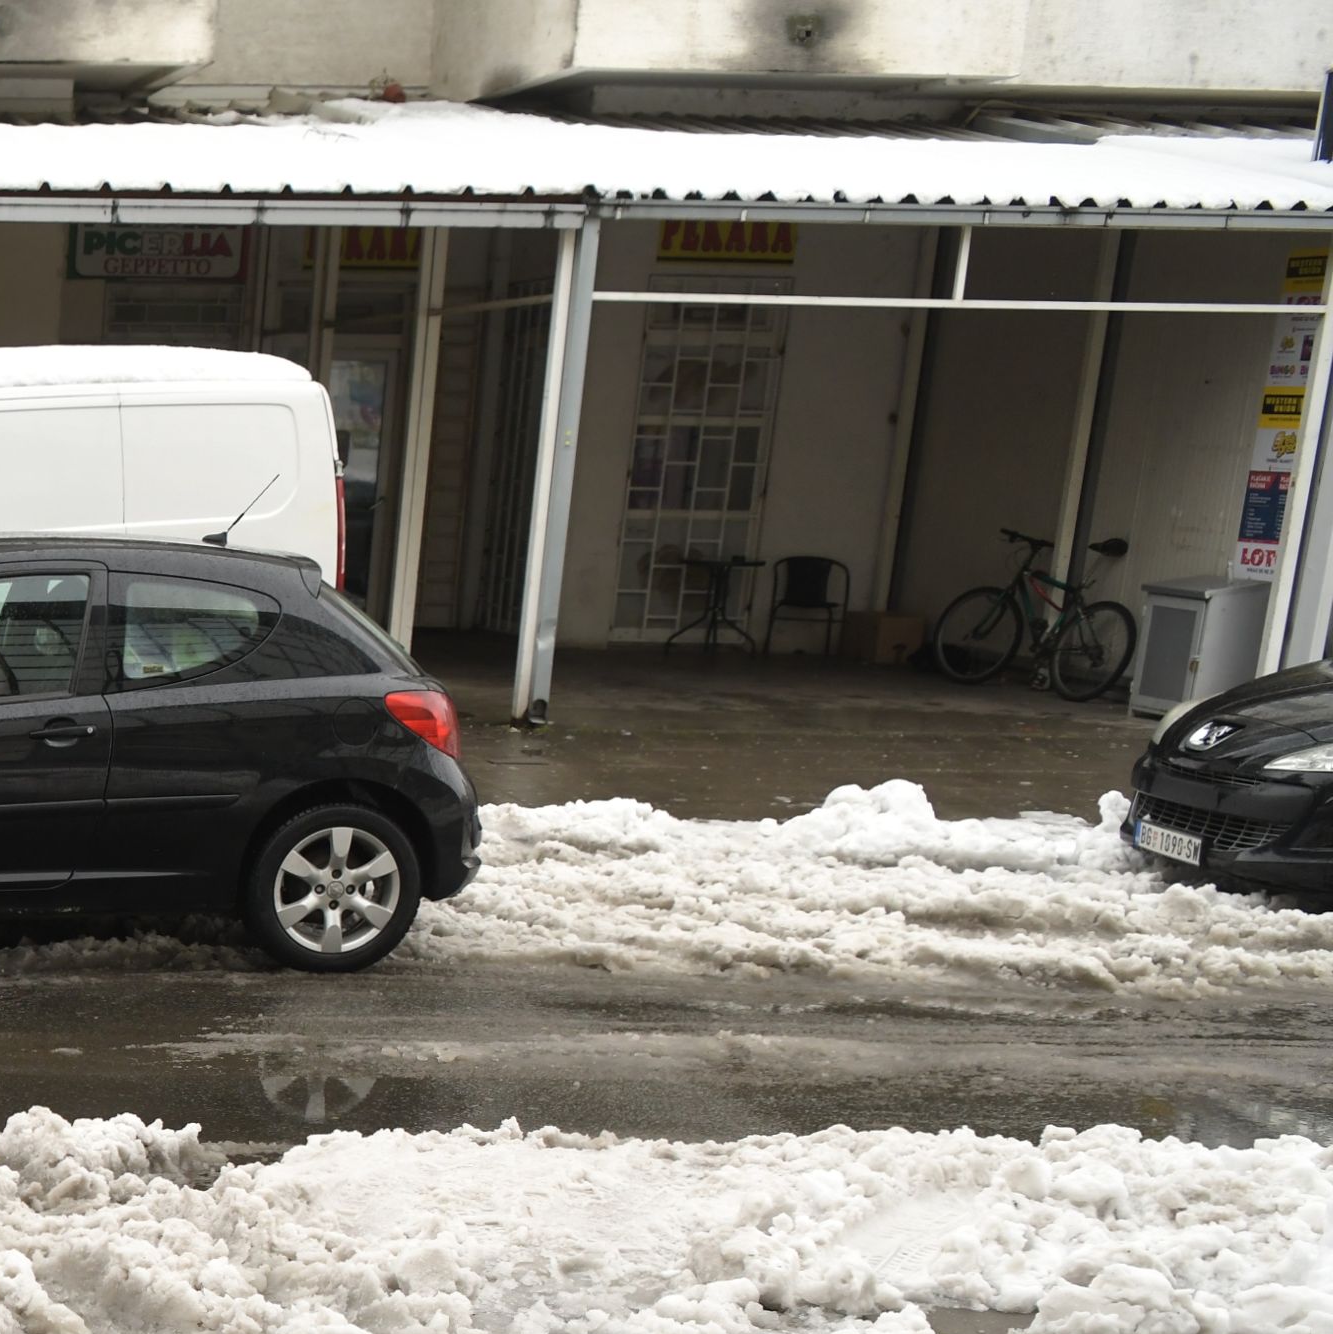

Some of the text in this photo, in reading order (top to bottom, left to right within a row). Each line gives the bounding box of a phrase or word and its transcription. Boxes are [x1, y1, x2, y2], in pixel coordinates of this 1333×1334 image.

[83, 231, 232, 257] PICERIJA
[103, 257, 212, 275] GEPPETTO
[1241, 548, 1276, 567] LOT
[1140, 824, 1153, 846] BG
